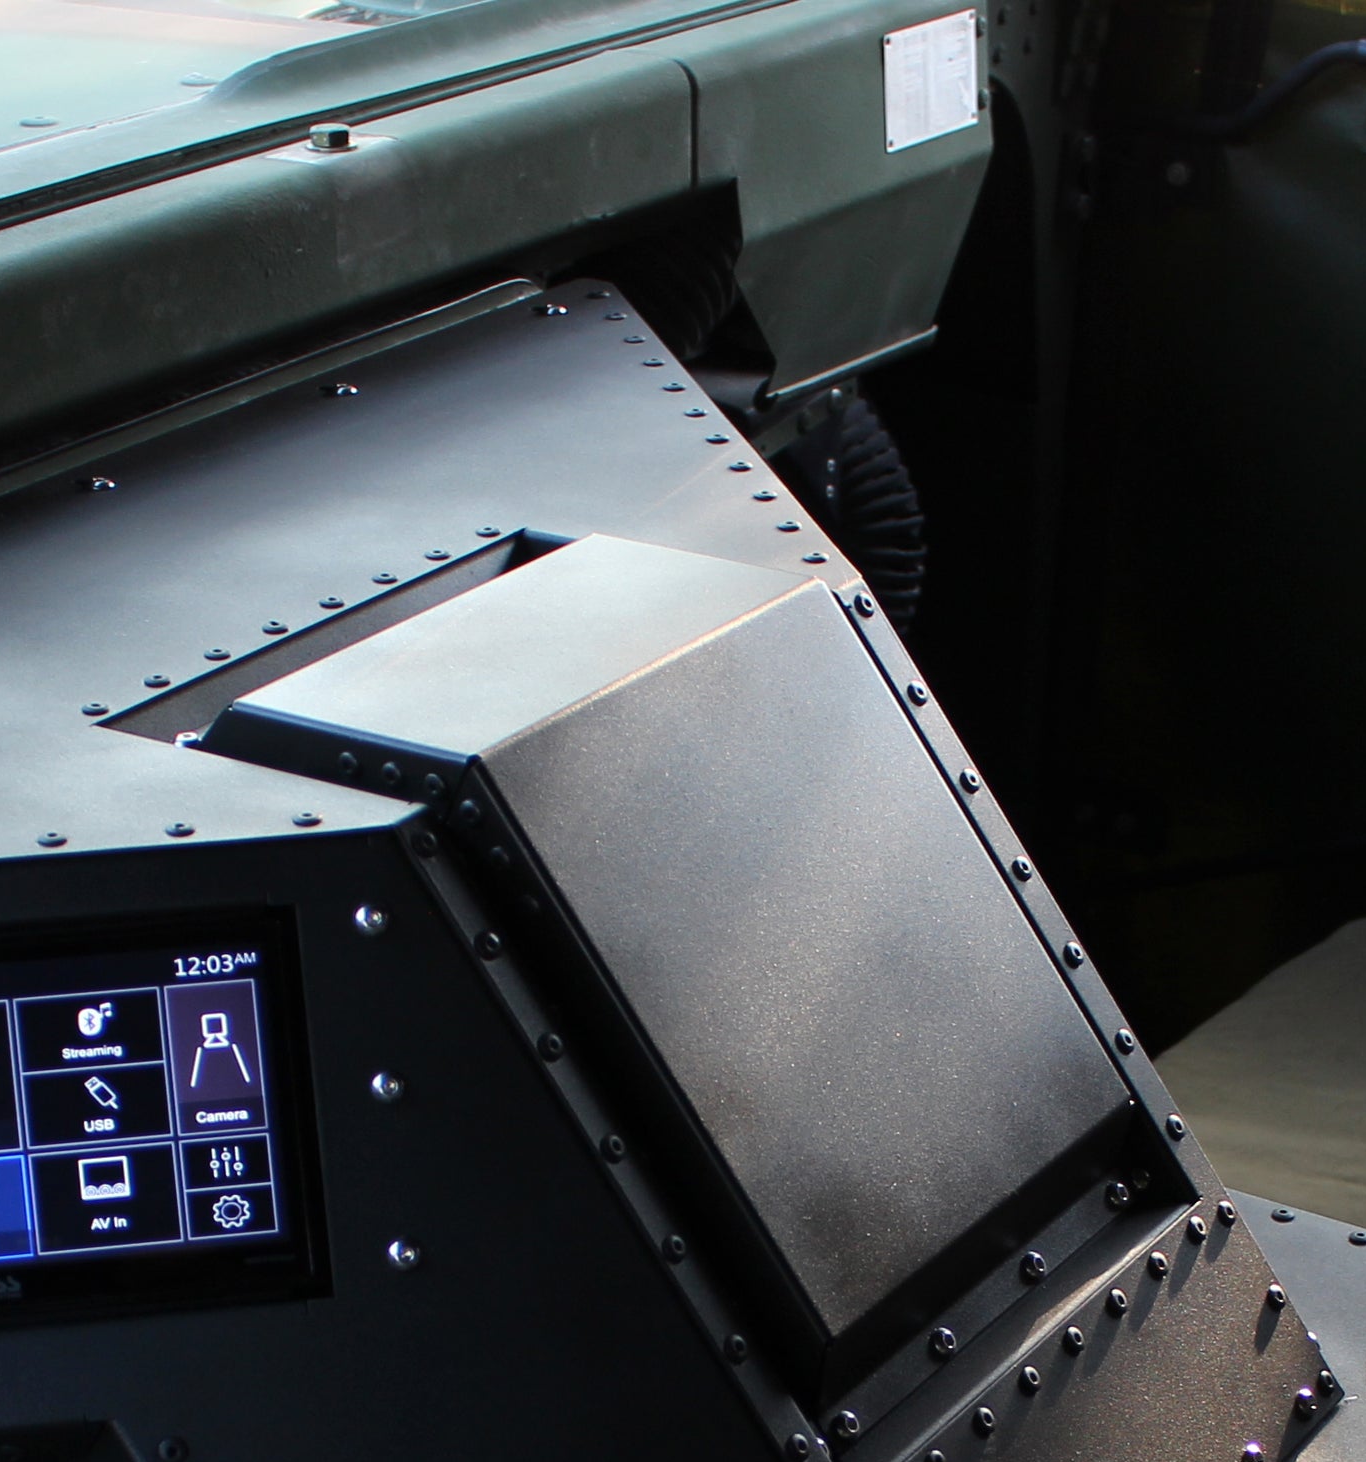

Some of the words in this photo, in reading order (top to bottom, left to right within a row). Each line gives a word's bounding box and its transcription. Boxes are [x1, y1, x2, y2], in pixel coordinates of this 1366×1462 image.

[62, 1045, 123, 1060] Streaming
[195, 1110, 249, 1124] Camera
[83, 1118, 115, 1133] USB
[91, 1217, 112, 1231] AV
[114, 1216, 128, 1229] In
